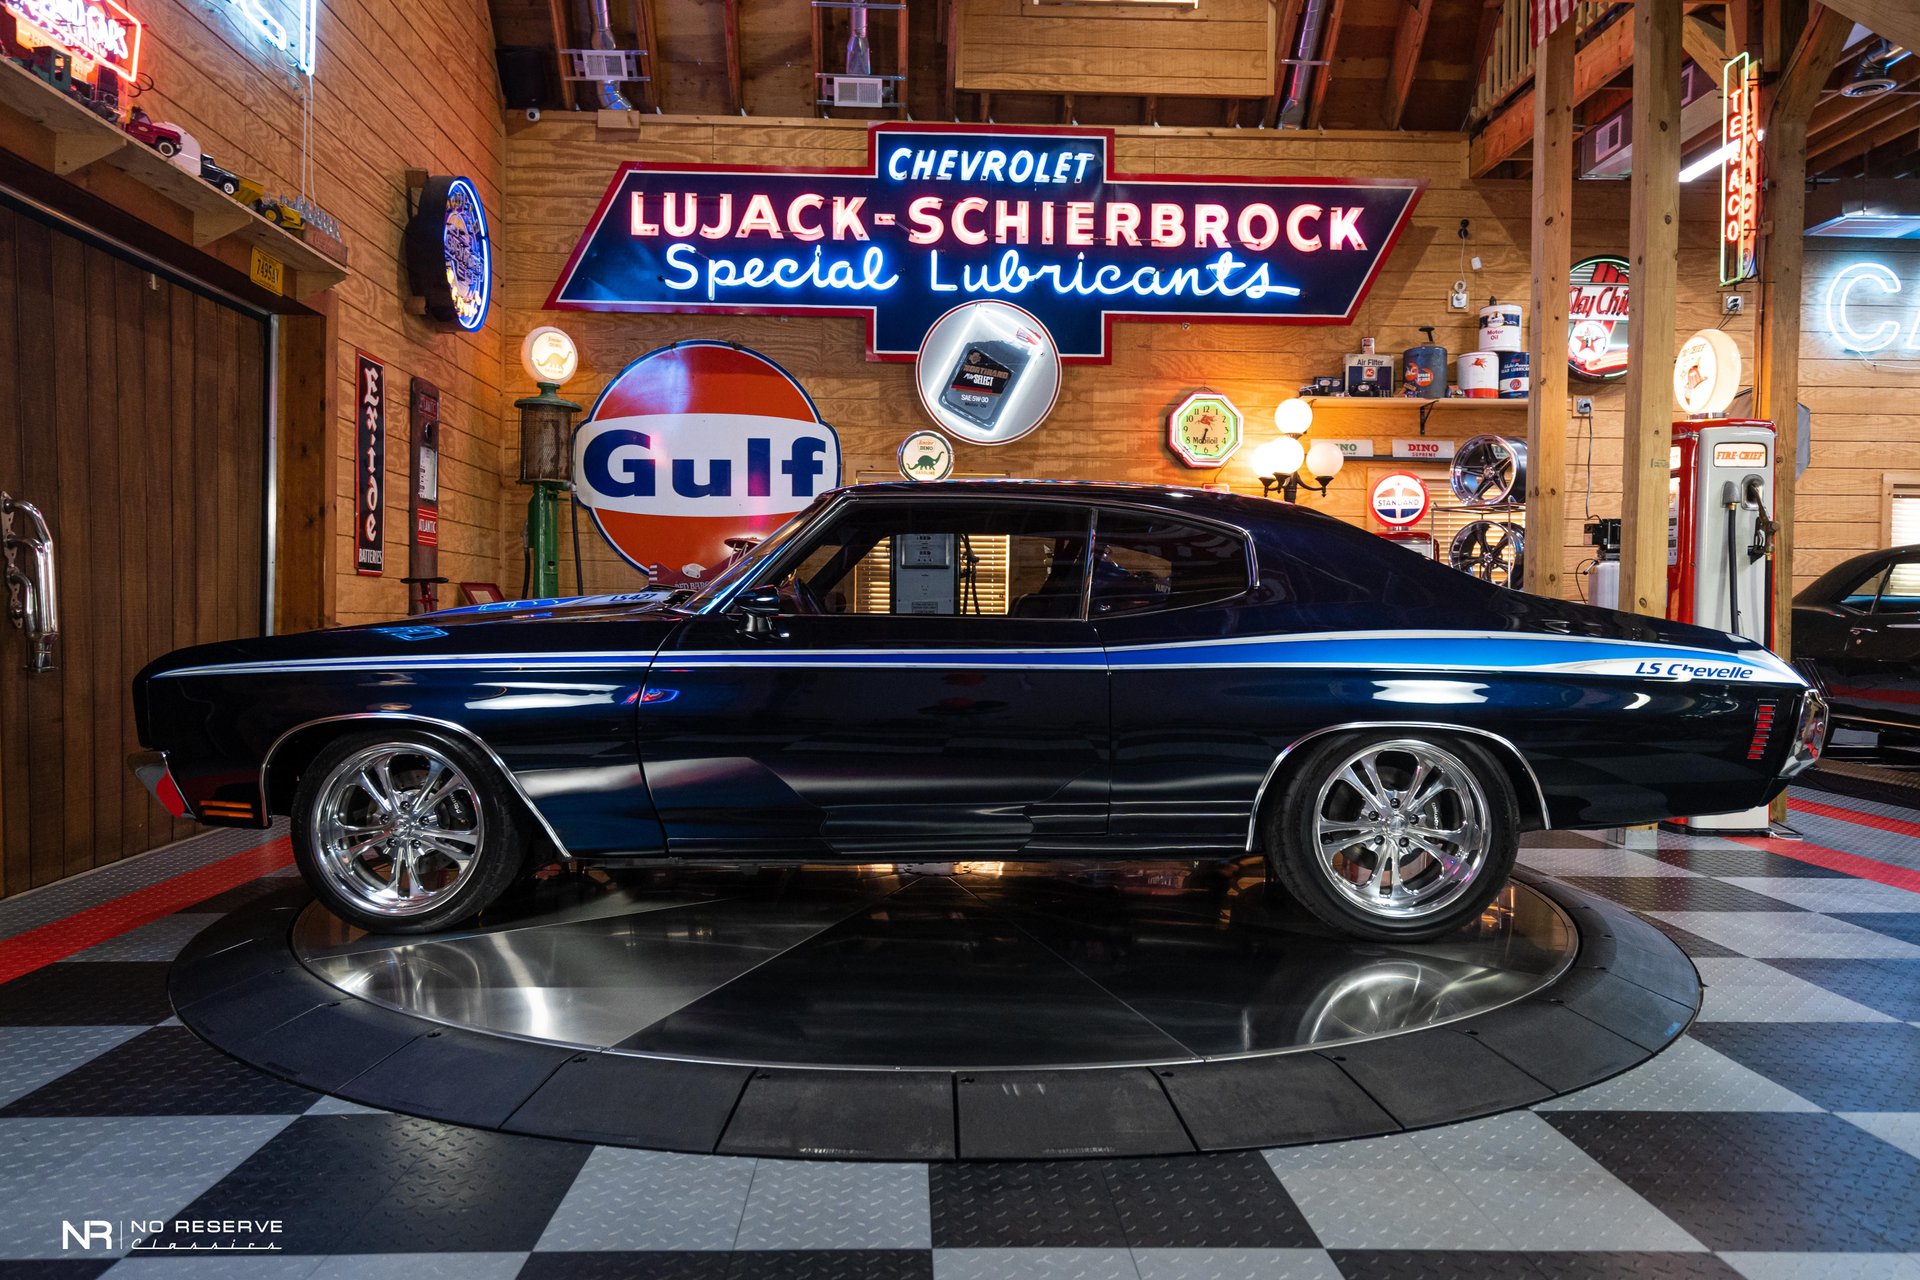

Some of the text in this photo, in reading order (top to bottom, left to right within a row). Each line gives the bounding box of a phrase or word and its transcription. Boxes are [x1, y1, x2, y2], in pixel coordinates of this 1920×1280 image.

[888, 147, 1095, 184] CHEVROLET
[664, 243, 1300, 301] Special Lubricants
[963, 365, 1009, 379] NORTHLAND
[1186, 436, 1190, 444] 8
[1408, 443, 1439, 452] DINO
[364, 367, 380, 543] Exide
[583, 429, 826, 498] Gulf
[1378, 499, 1420, 507] STANDARD
[418, 517, 437, 535] ATLANTIC
[358, 548, 382, 565] BATTERIES
[1635, 662, 1753, 679] LS Chevelle
